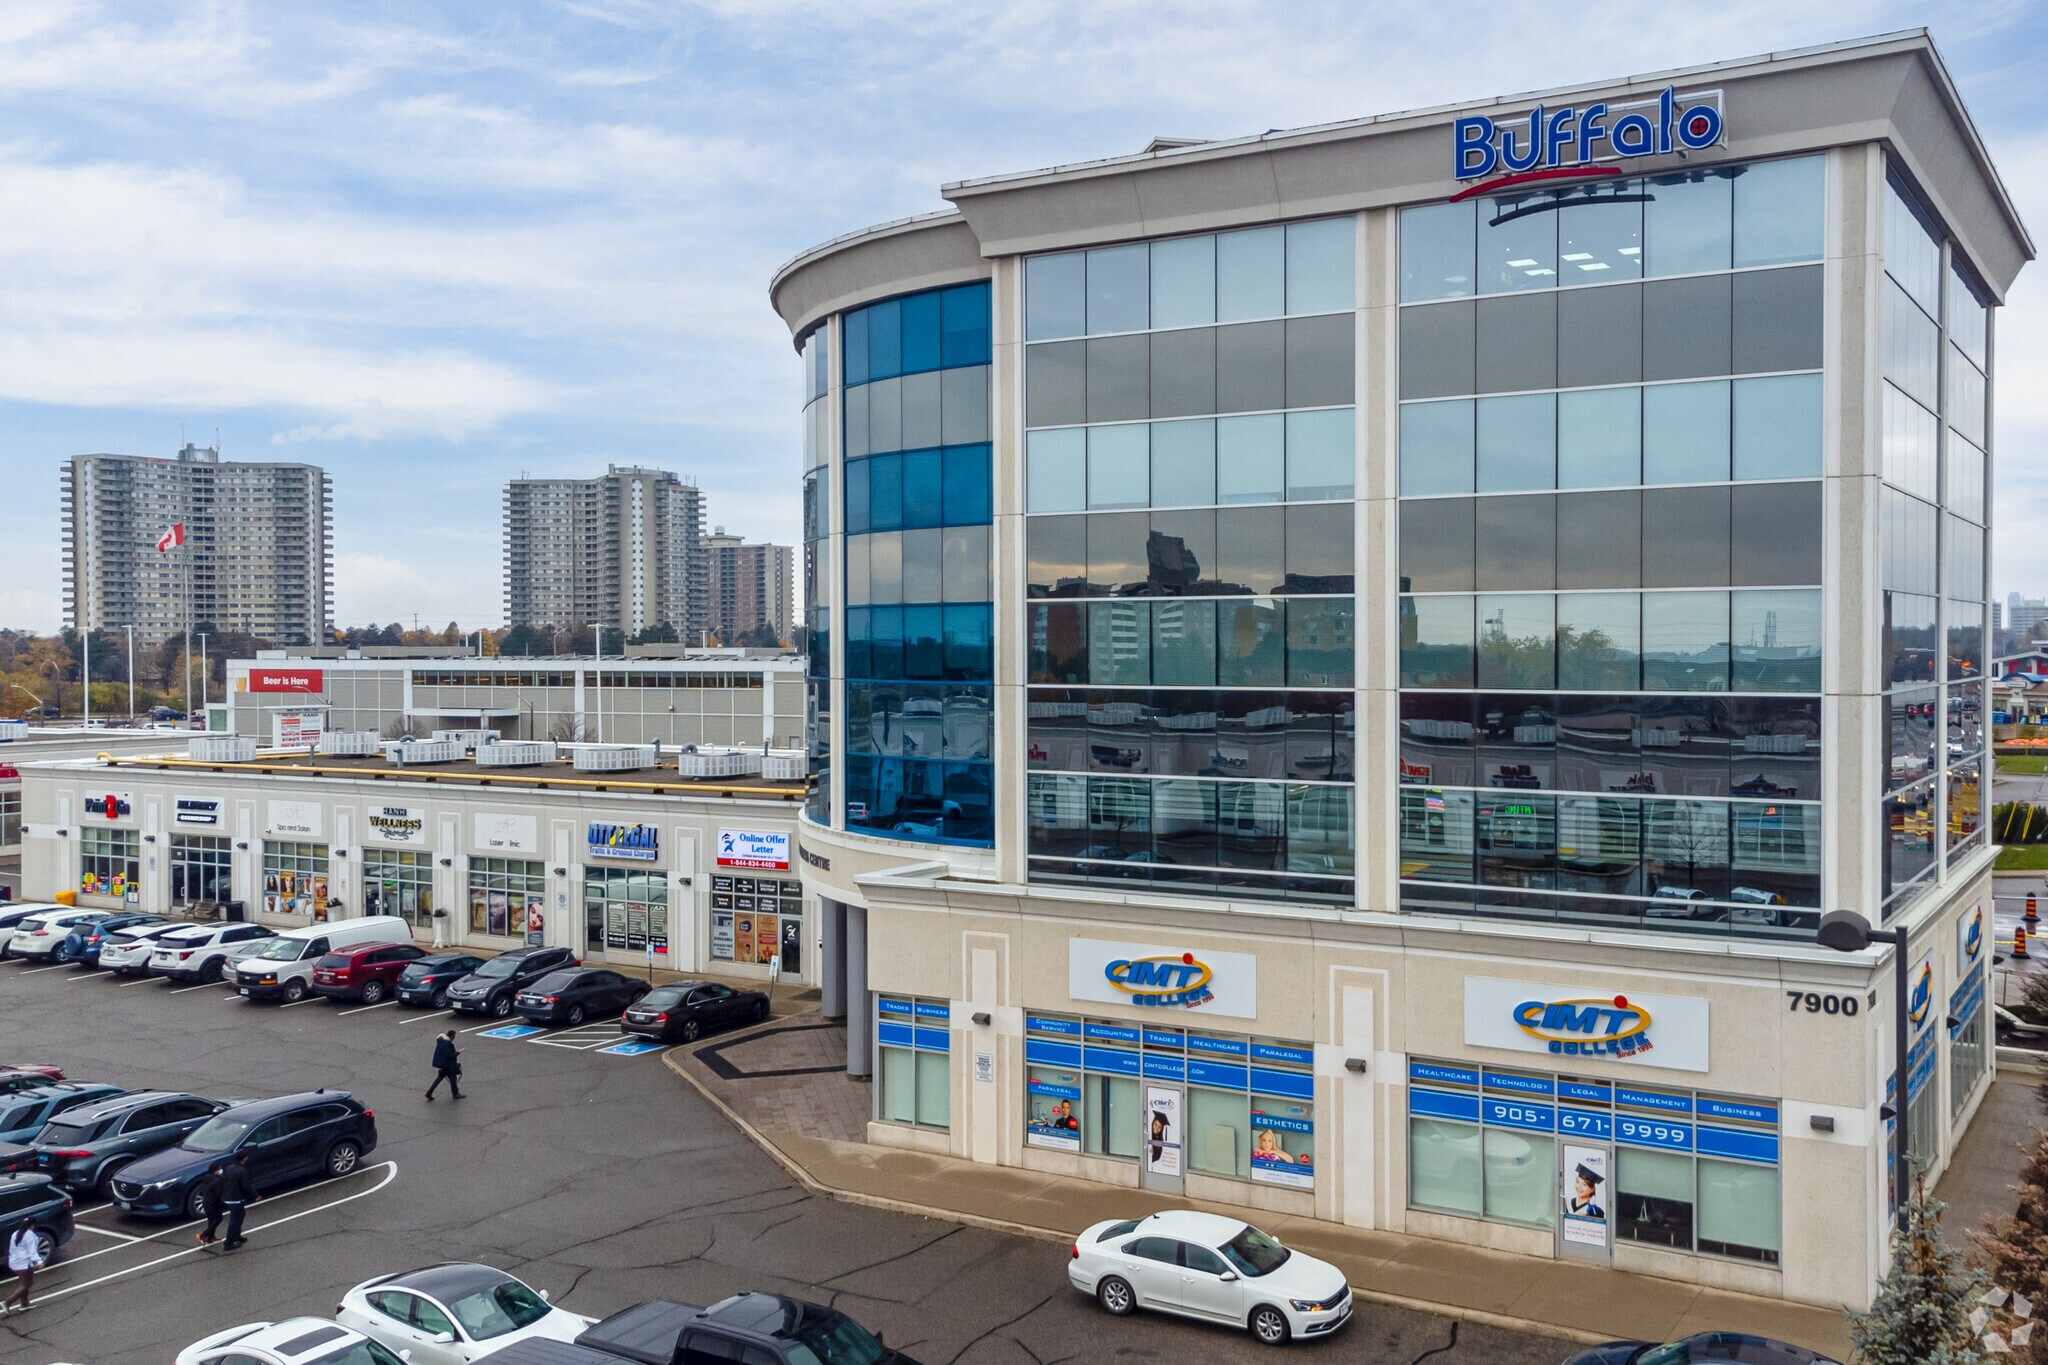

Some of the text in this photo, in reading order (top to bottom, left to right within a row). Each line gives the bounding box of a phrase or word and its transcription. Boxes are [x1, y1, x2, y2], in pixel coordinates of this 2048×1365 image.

[1453, 84, 1723, 181] Buffalo
[263, 676, 308, 685] Beer is Here
[370, 816, 422, 830] WELLNESS
[740, 833, 785, 844] Online Offer
[752, 844, 774, 854] Letter
[1105, 960, 1203, 987] CIMT
[1133, 984, 1210, 1006] COLLEGE
[886, 1003, 909, 1011] TRADES
[1186, 1000, 1201, 1009] Since
[1786, 991, 1858, 1017] 7900
[917, 1007, 948, 1015] BUSINESS
[1036, 1018, 1071, 1028] COMMUNITY
[1513, 1001, 1640, 1035] CIMT
[1041, 1024, 1066, 1033] SERVICE
[1090, 1028, 1134, 1038] ACCOUNTING
[1150, 1034, 1176, 1043] TRADES
[1548, 1031, 1649, 1055] COLLEGE
[1194, 1040, 1240, 1051] HEALTHCARE
[1260, 1048, 1302, 1059] PARALEGAL
[1616, 1050, 1636, 1059] Since
[1418, 1068, 1472, 1080] HEALTHCARE
[1492, 1078, 1548, 1090] TECHNOLOGY
[1038, 1086, 1072, 1094] PARALEGAL
[1571, 1088, 1599, 1096] LEGAL
[1622, 1094, 1686, 1107] MANAGEMENT
[1713, 1105, 1761, 1117] BUSINESS
[1256, 1117, 1309, 1131] ESTHETICS
[1494, 1106, 1684, 1142] 905- 671- 9999
